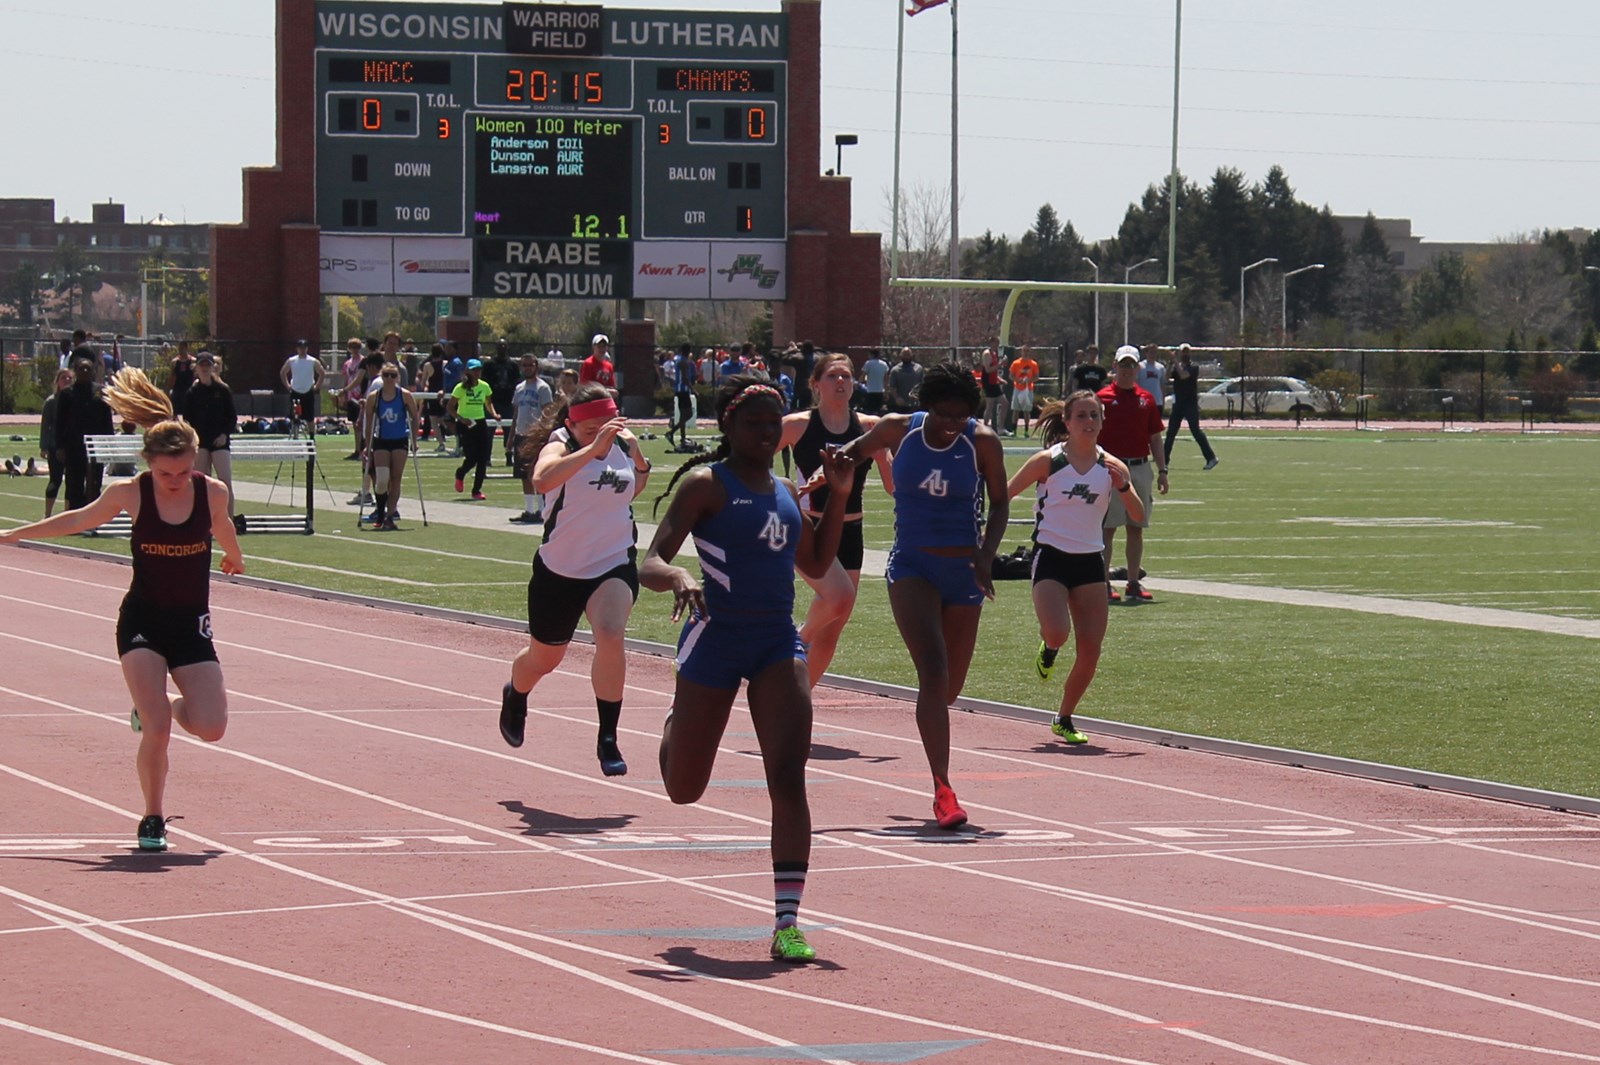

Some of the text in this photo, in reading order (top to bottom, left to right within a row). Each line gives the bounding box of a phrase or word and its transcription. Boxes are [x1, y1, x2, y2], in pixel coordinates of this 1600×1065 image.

[513, 10, 600, 28] WARRIOR
[318, 13, 780, 47] WISCONSIN LUTHERAN
[531, 31, 586, 48] FIELD
[363, 61, 413, 83] NACC
[676, 70, 756, 92] CHAMPS.
[506, 70, 602, 102] 20:15
[426, 93, 461, 108] T.O.L.
[648, 99, 682, 113] T.O.L.
[363, 99, 382, 130] 0
[748, 108, 765, 138] 0
[438, 119, 449, 138] 3
[475, 117, 622, 135] Women 100 Meter
[659, 124, 670, 144] 3
[491, 136, 549, 149] Anderson
[491, 149, 535, 161] Dunson
[395, 163, 431, 177] DOWN
[491, 162, 549, 175] Langston
[669, 167, 716, 181] BALL ON
[395, 207, 430, 221] TO GO
[684, 211, 706, 224] QTR
[746, 208, 753, 230] 1
[485, 223, 491, 235] 1
[571, 214, 629, 238] 12.1
[506, 241, 600, 265] RAABE
[319, 258, 358, 271] QPS
[493, 271, 613, 296] STADIUM
[917, 469, 949, 497] AU
[757, 511, 789, 552] AU
[141, 541, 208, 556] CONCORDIA
